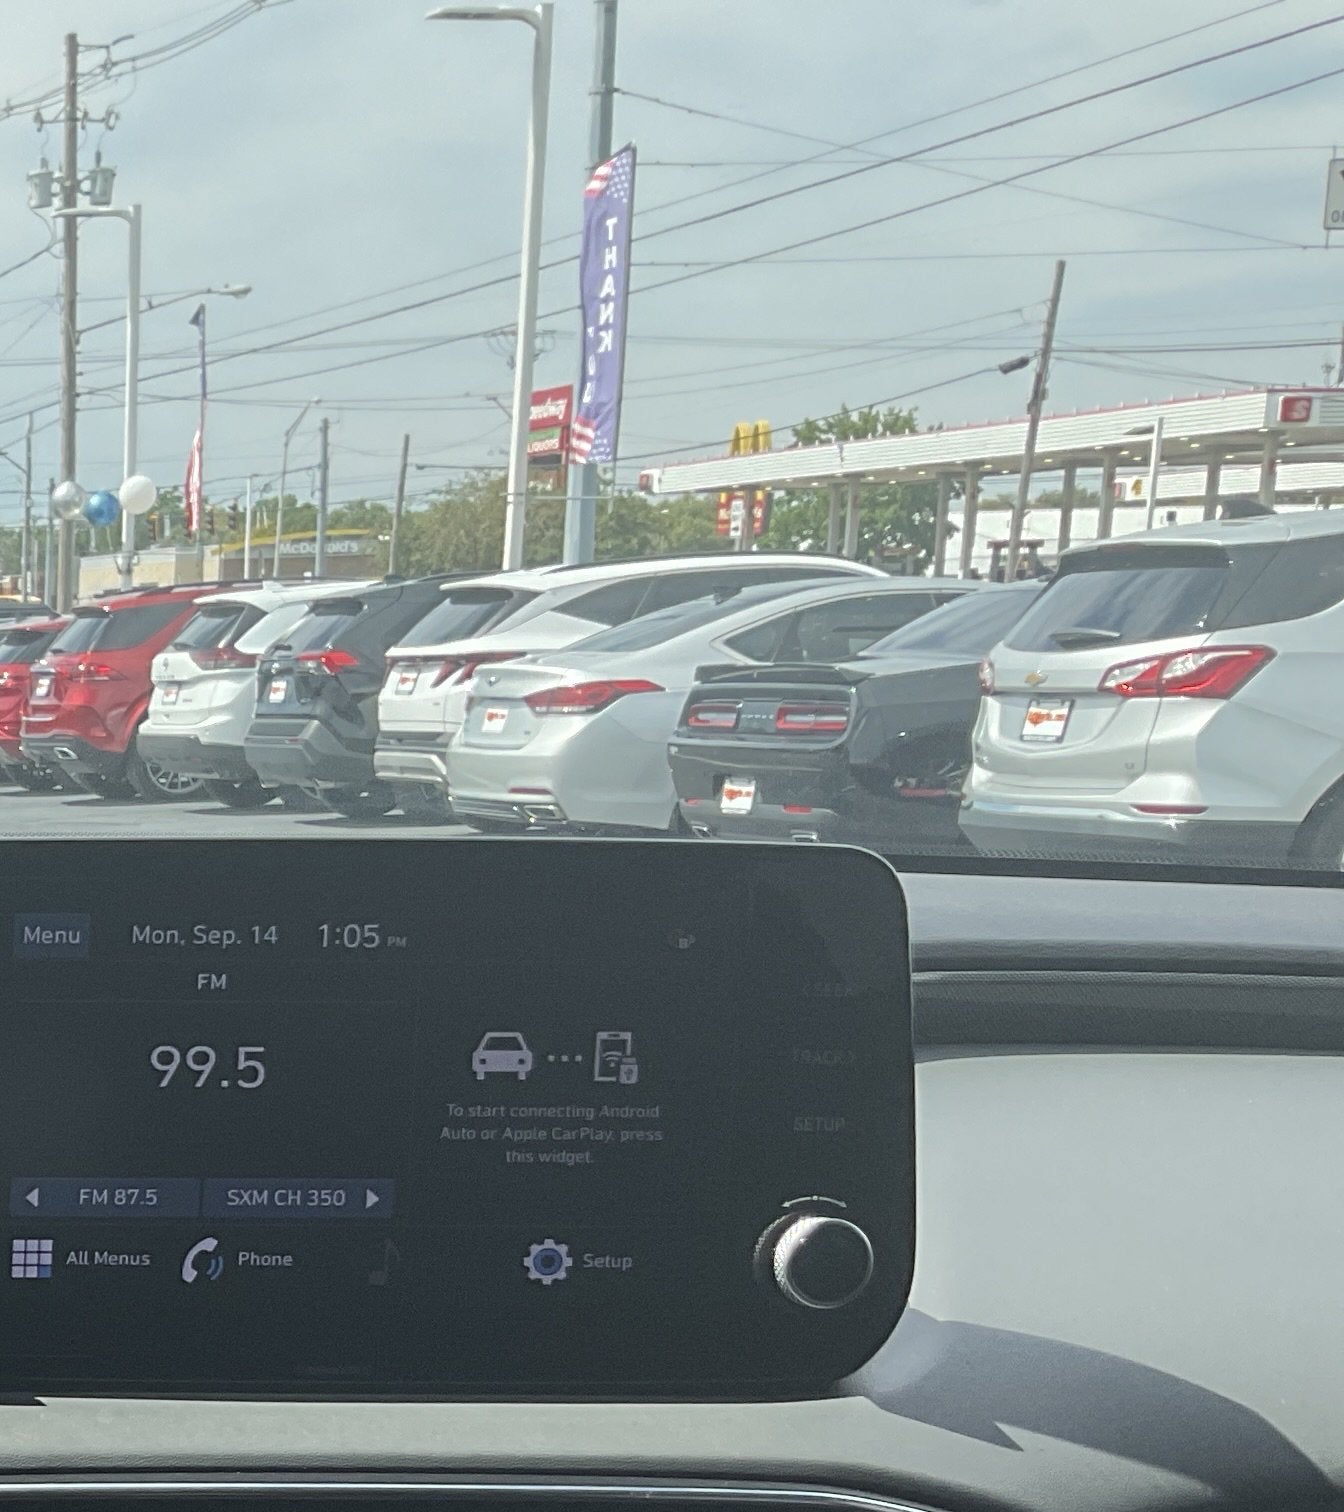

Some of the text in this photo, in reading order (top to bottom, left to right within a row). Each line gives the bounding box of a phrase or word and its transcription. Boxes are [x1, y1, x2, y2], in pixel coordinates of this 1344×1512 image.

[279, 541, 359, 553] McDoald's
[23, 925, 81, 945] Menu
[192, 925, 242, 949] Sep.
[251, 925, 279, 945] 14
[318, 923, 407, 948] 1:05 PM
[197, 973, 227, 990] FM
[150, 1046, 266, 1088] 99.5
[446, 1103, 659, 1121] To start connecting Android
[440, 1127, 476, 1140] Auto
[481, 1130, 496, 1140] or
[502, 1127, 547, 1143] Apple
[620, 1130, 663, 1143] press
[506, 1150, 595, 1166] this widget.
[79, 1189, 158, 1205] FM 87.5
[226, 1190, 346, 1206] SXM CH 350
[66, 1251, 151, 1266] All Menus
[238, 1251, 293, 1267] Phone
[583, 1253, 633, 1271] Setup
